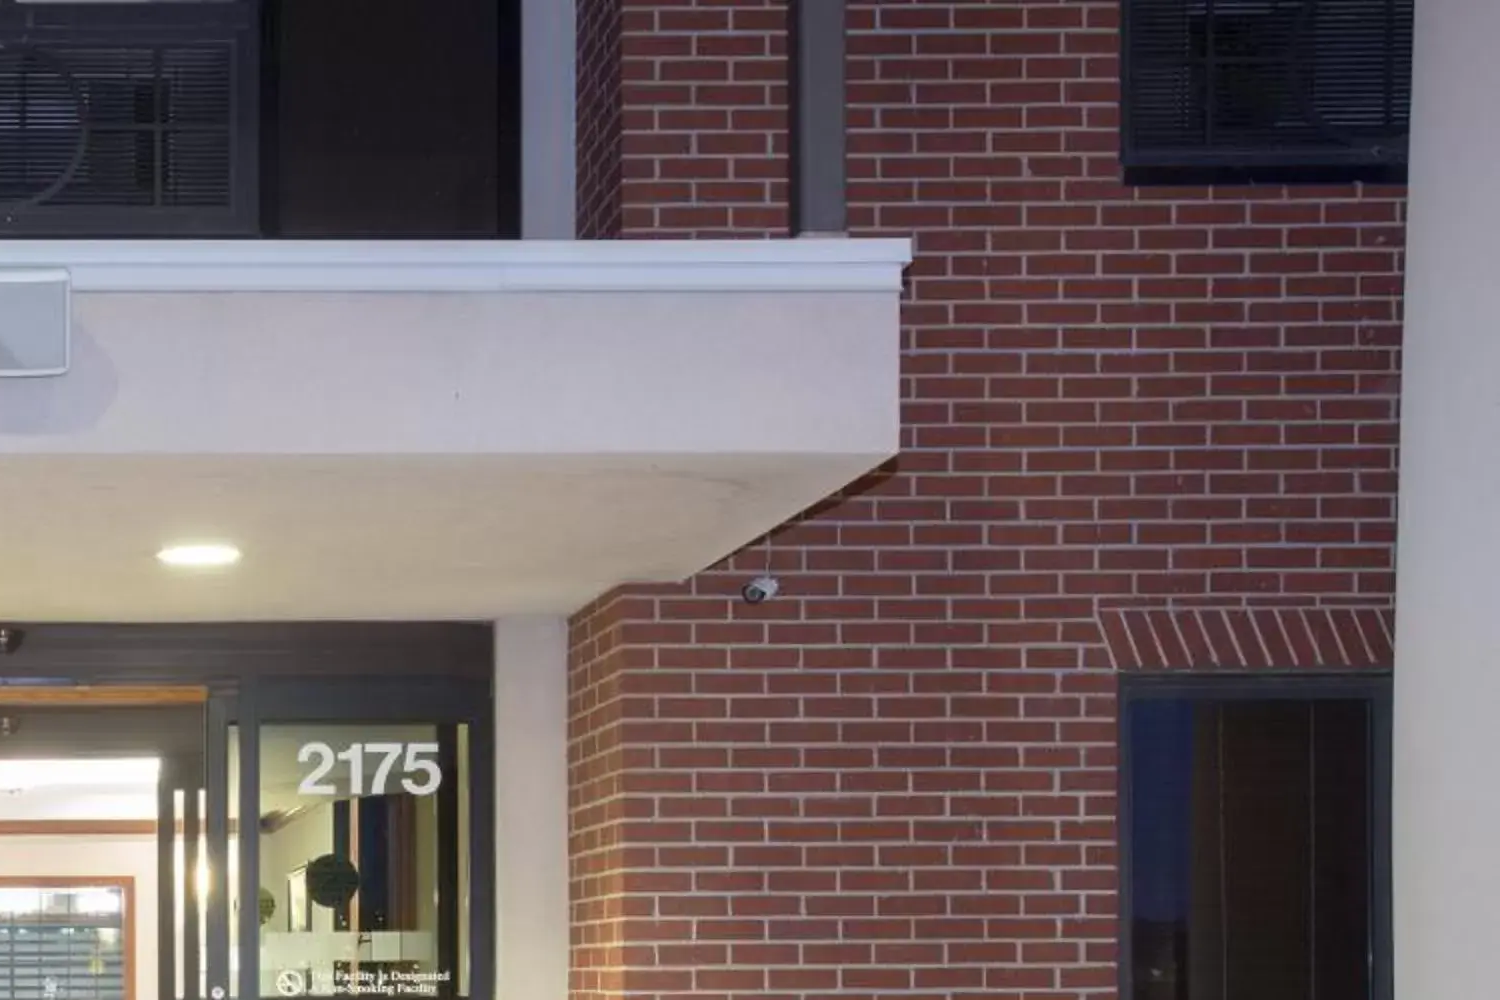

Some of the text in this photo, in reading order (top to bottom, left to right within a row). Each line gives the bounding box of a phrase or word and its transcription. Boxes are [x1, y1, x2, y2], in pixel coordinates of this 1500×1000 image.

[298, 742, 442, 796] 2175
[335, 970, 375, 983] Facility
[391, 970, 451, 983] Designated
[397, 983, 437, 996] Facility
